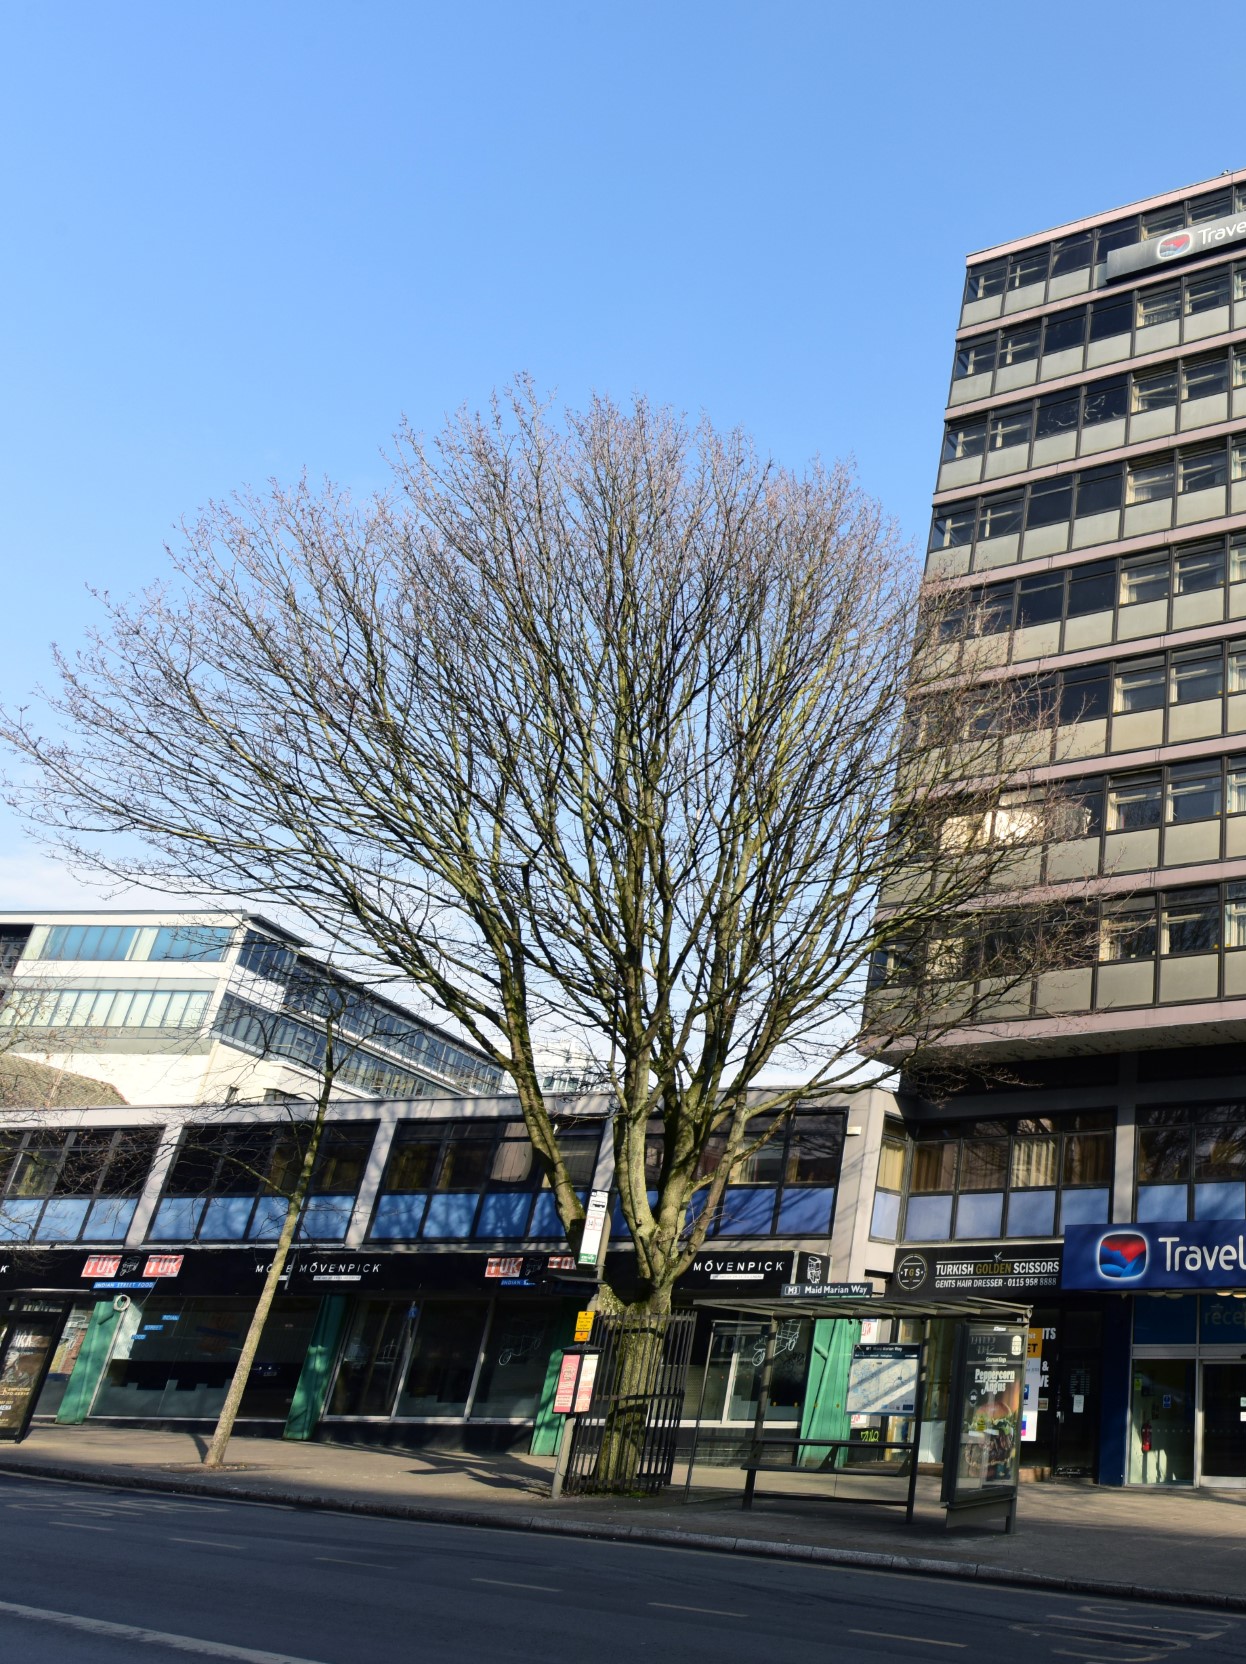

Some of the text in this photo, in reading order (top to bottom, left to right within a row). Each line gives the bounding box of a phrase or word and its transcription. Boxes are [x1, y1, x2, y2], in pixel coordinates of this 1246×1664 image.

[87, 1257, 181, 1274] TUK TUK
[488, 1258, 521, 1274] TUK
[936, 1261, 1060, 1276] TURKISH GOLDEN SCISSORS
[787, 1284, 868, 1295] M3 Maid Marian Way
[935, 1279, 956, 1288] GENTS
[956, 1279, 972, 1288] HAIR
[973, 1278, 1003, 1288] DRESSER
[1007, 1278, 1024, 1287] 0115
[1025, 1278, 1038, 1287] 958
[1039, 1277, 1057, 1286] 8888
[974, 1368, 1016, 1382] Peppercorn
[980, 1381, 1007, 1395] Angus
